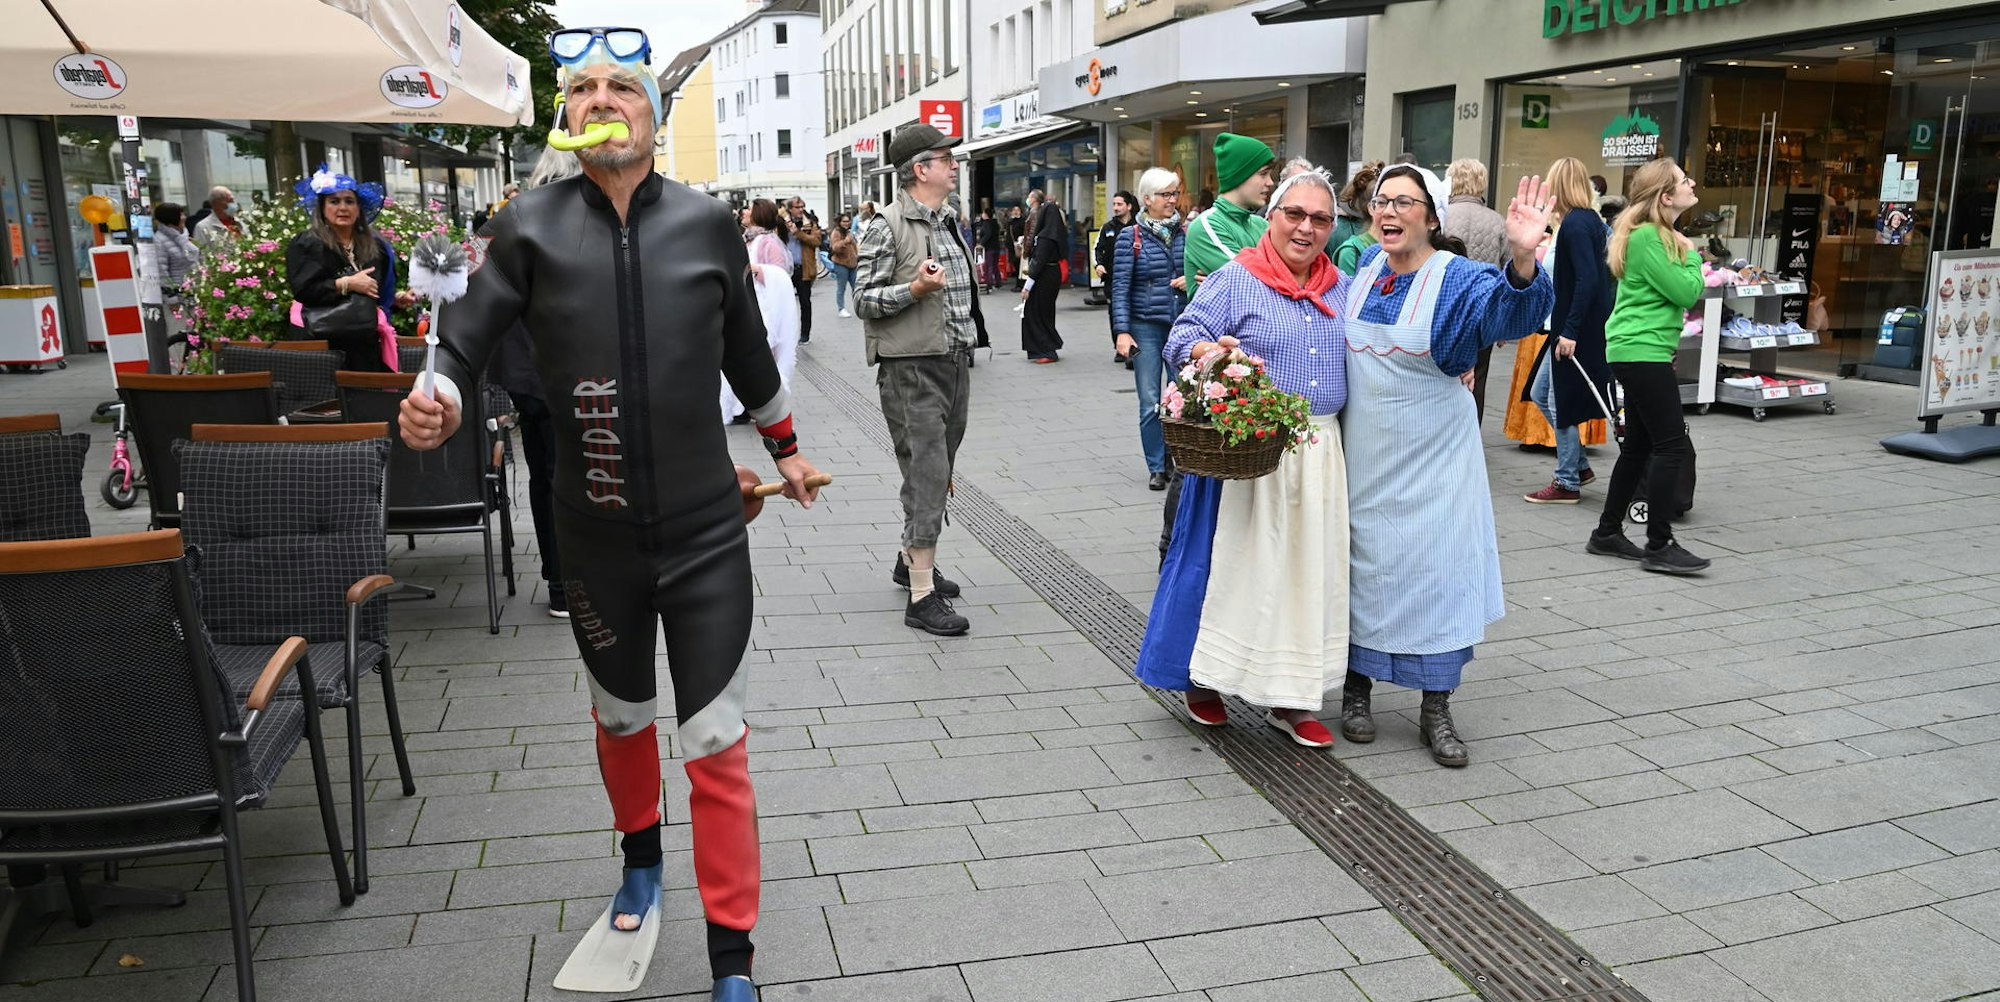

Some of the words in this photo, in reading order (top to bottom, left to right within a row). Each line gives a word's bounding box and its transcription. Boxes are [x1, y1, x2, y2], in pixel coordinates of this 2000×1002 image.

[1457, 102, 1479, 120] 153
[1527, 100, 1546, 123] D
[1603, 137, 1615, 146] SO
[1615, 134, 1644, 146] SCHÖN
[1645, 134, 1660, 144] IST
[1915, 124, 1931, 144] D
[1602, 144, 1658, 157] DRAUSSEN
[1791, 240, 1810, 249] FILA
[573, 379, 627, 506] SPIDER
